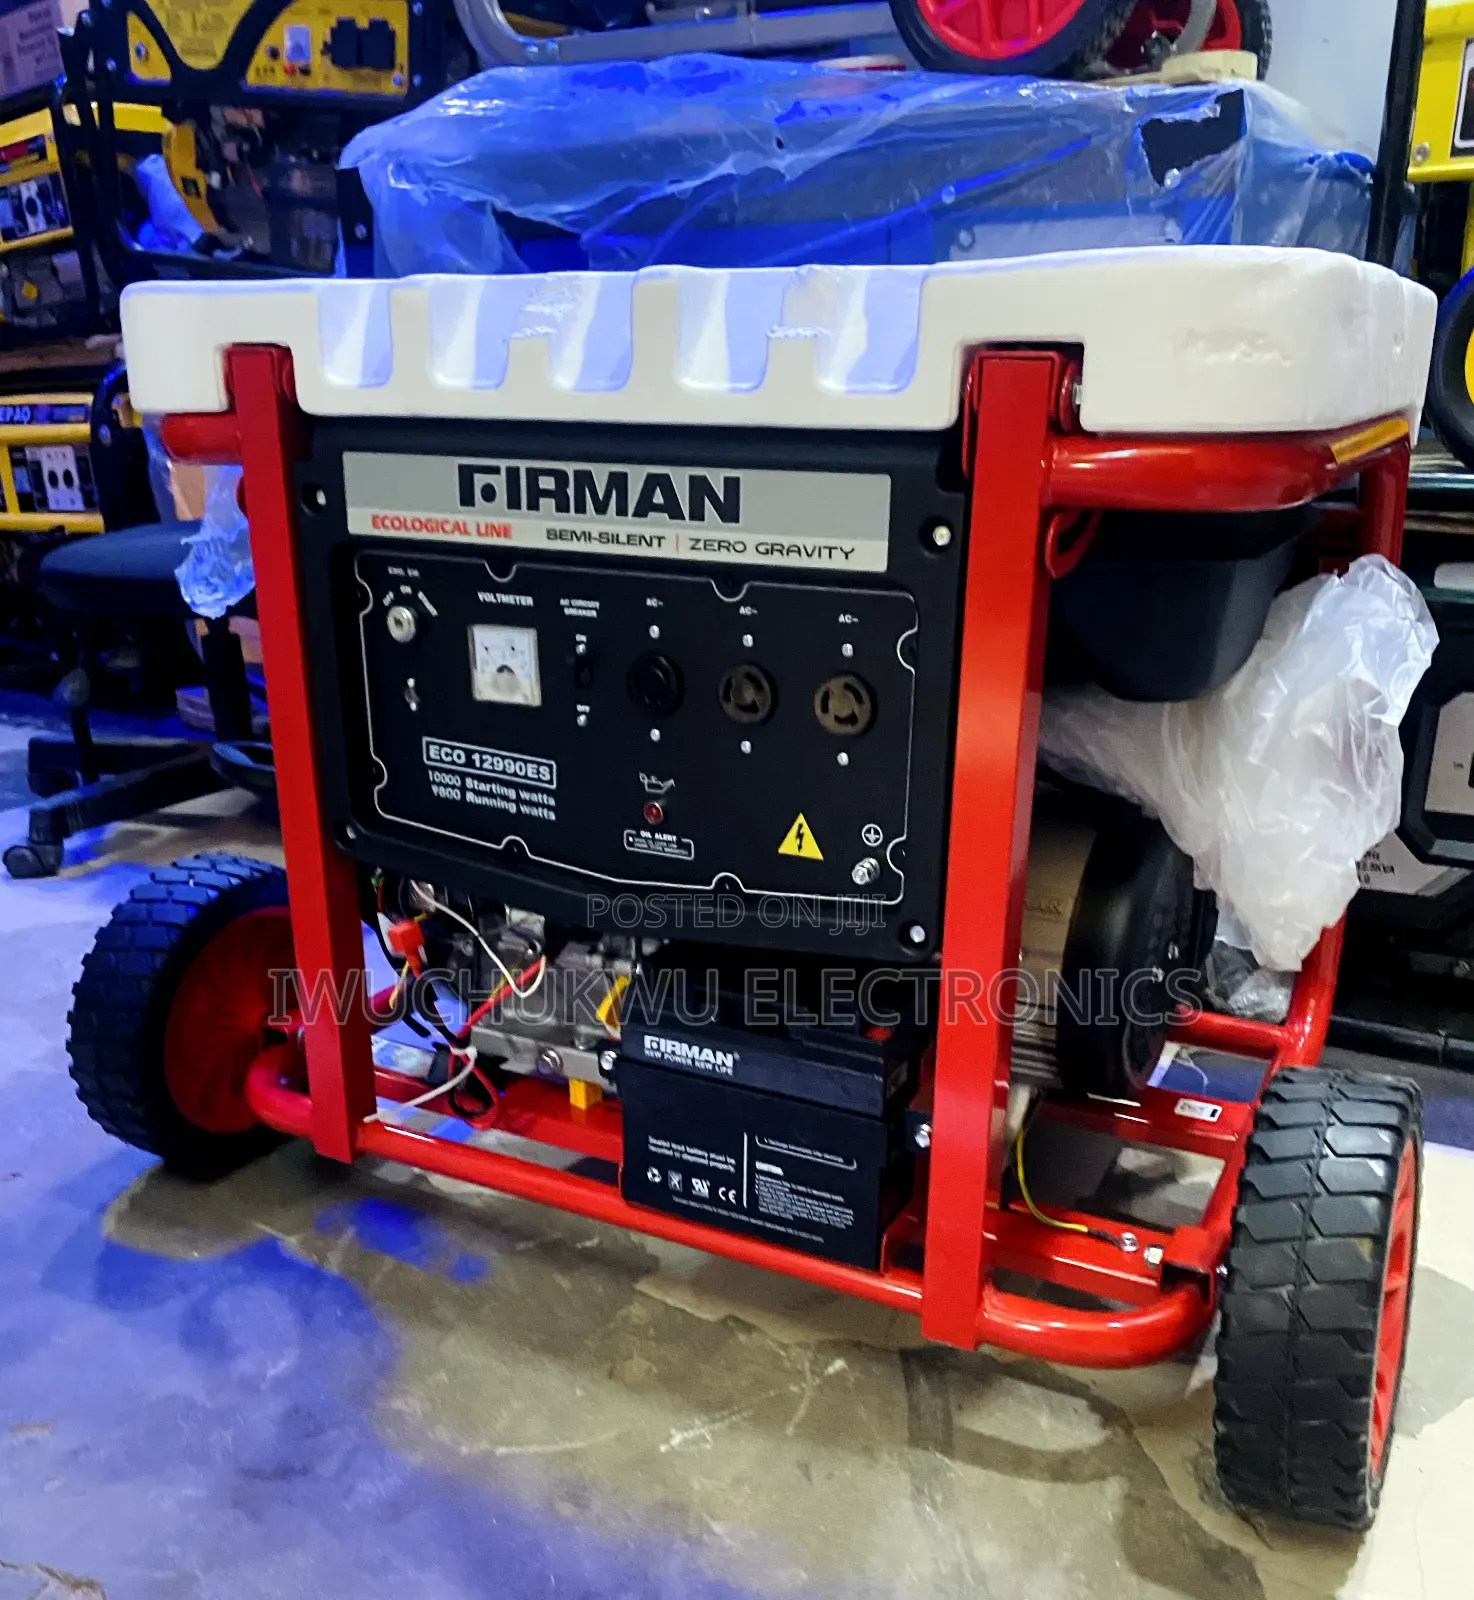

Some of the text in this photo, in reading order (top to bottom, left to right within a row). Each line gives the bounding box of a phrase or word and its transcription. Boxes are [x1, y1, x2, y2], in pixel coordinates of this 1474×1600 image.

[457, 463, 741, 524] FIRMAN
[371, 514, 512, 539] ECOLOGICAL LINE
[546, 528, 666, 548] SEMI-SILENT
[689, 537, 855, 560] ZERO GRAVITY
[477, 591, 534, 607] VOLTMETER
[429, 744, 551, 781] ECO 12990ES
[428, 769, 556, 807] 10000 Starting watts
[465, 790, 517, 815] Running
[519, 802, 556, 821] watts
[654, 832, 677, 842] ALERT
[644, 1034, 734, 1068] FIRMAN
[644, 1047, 733, 1077] NEW POWER NEW LIFE
